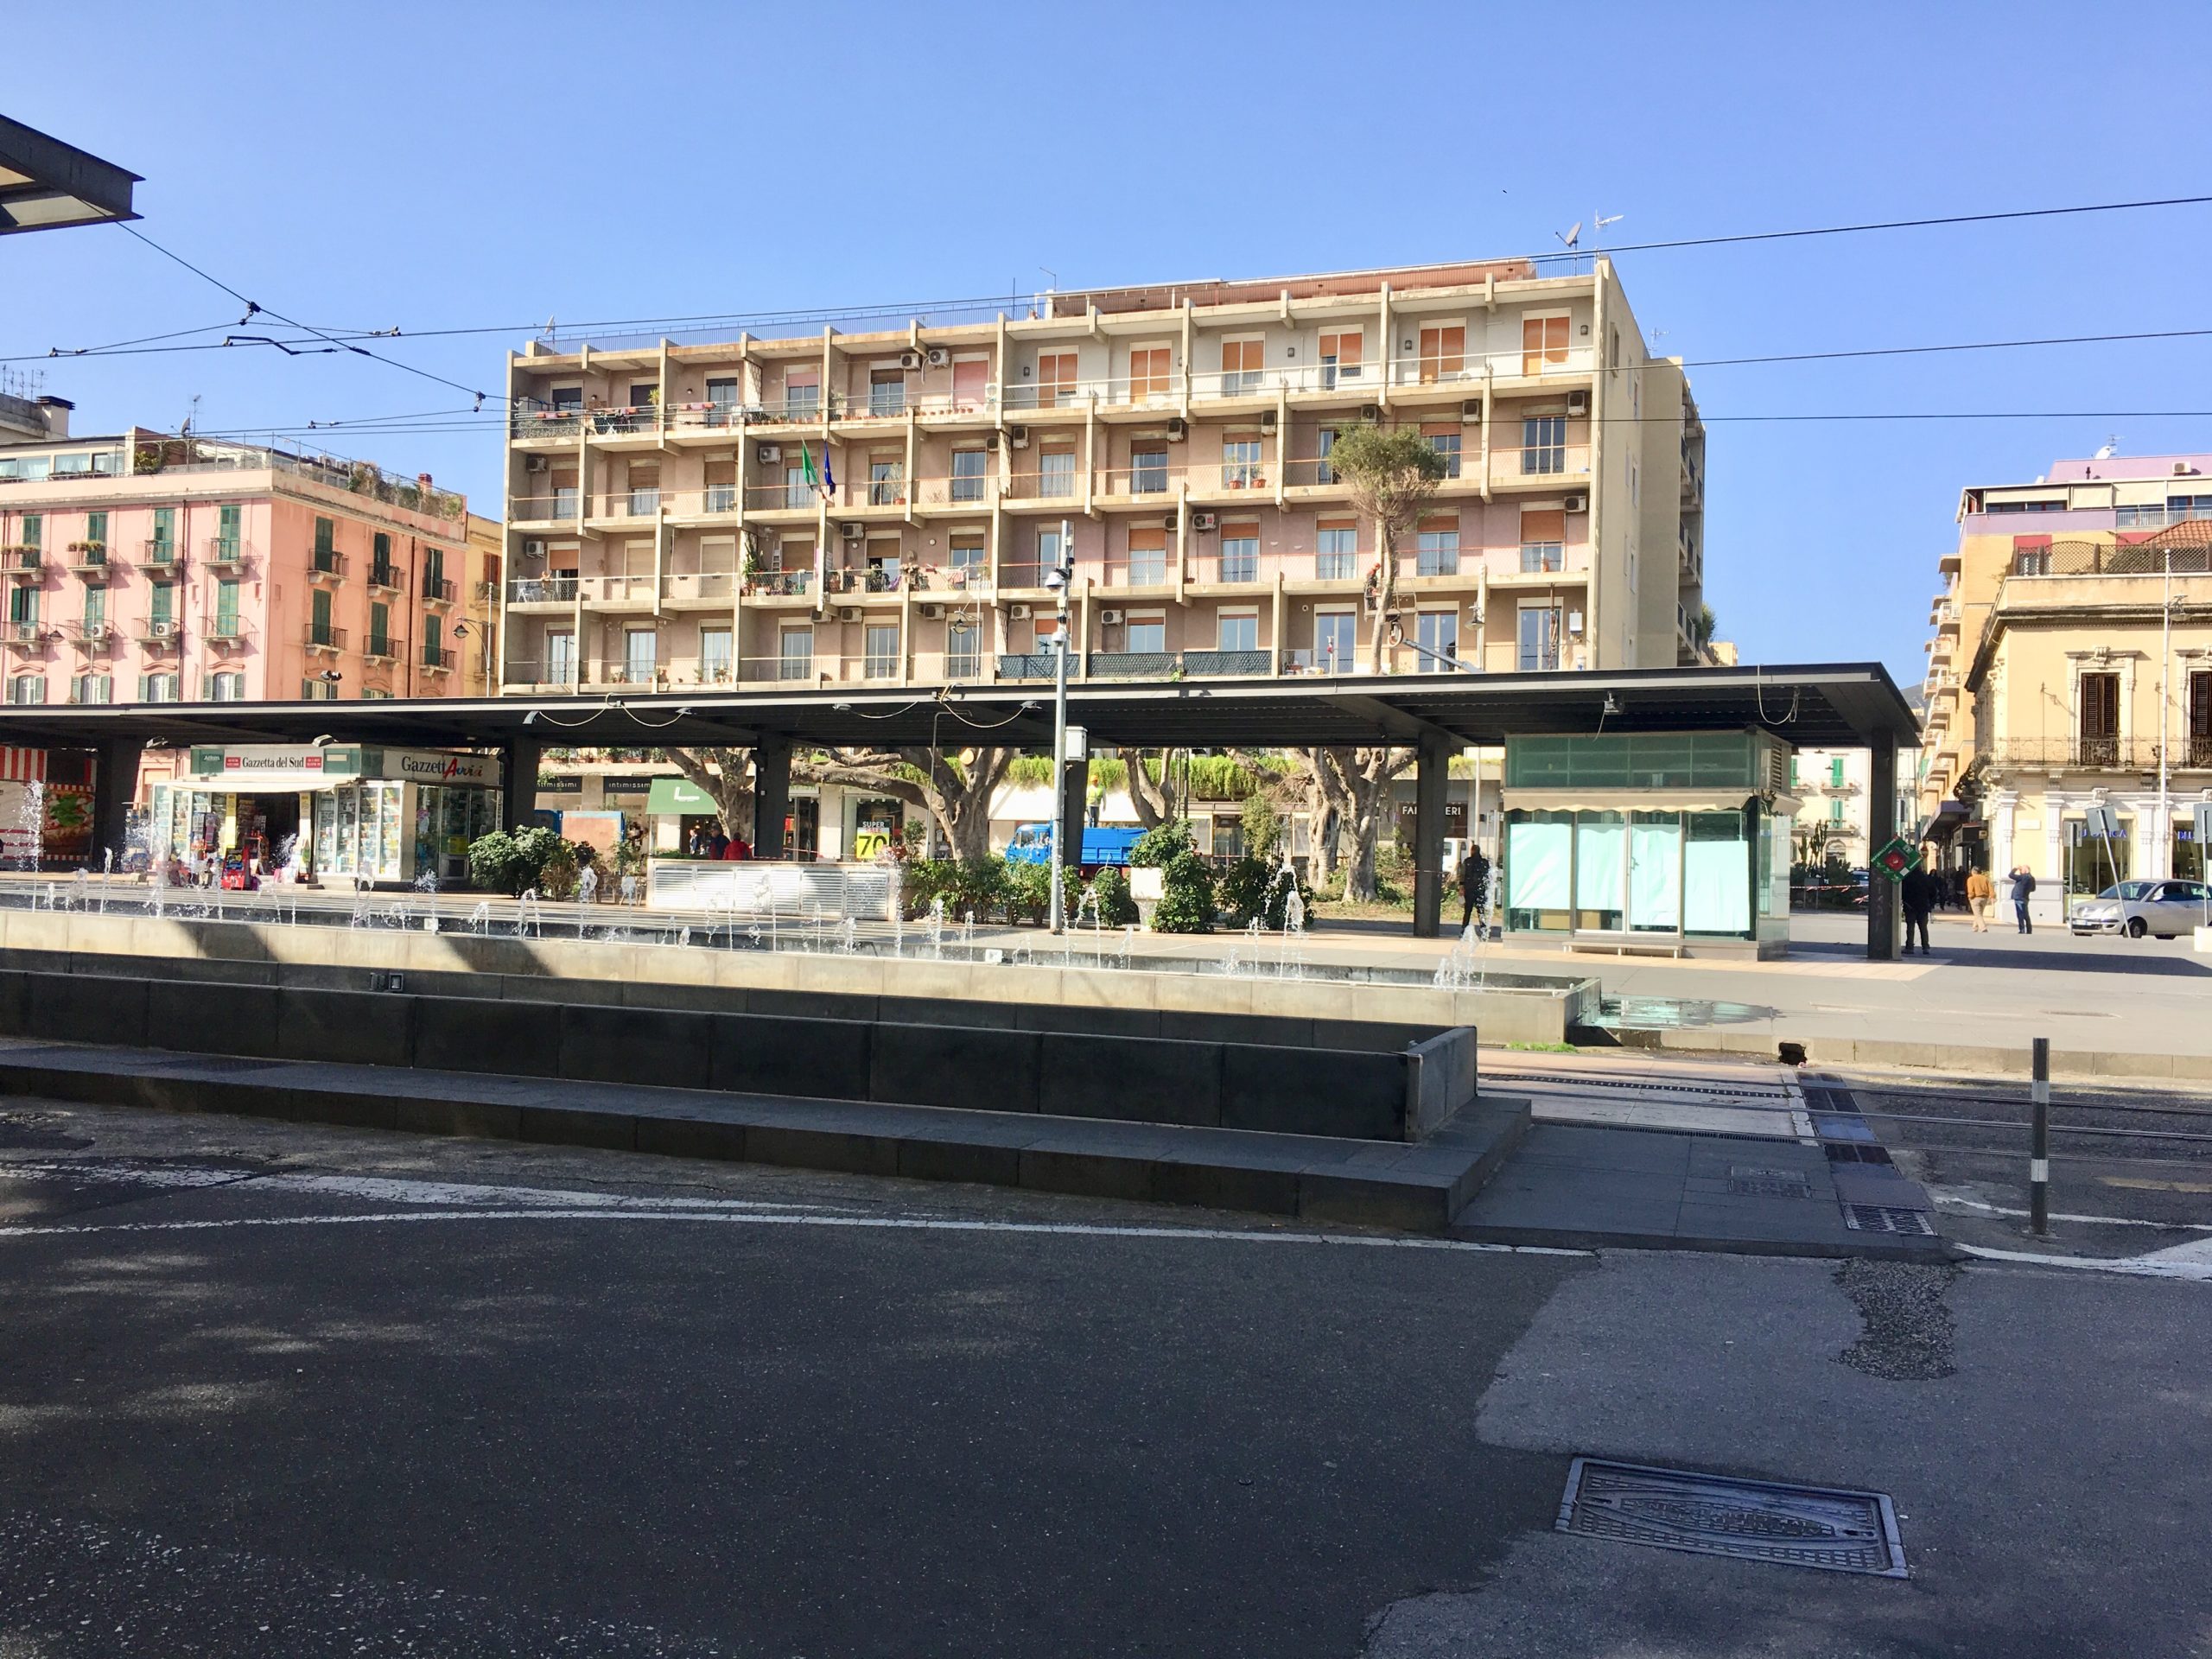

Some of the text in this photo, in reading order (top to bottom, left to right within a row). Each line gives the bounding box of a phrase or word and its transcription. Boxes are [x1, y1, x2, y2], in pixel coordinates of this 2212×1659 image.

[242, 757, 275, 768] Gazzetta
[276, 756, 288, 768] del
[289, 757, 304, 768] Sud
[858, 835, 887, 857] 70
